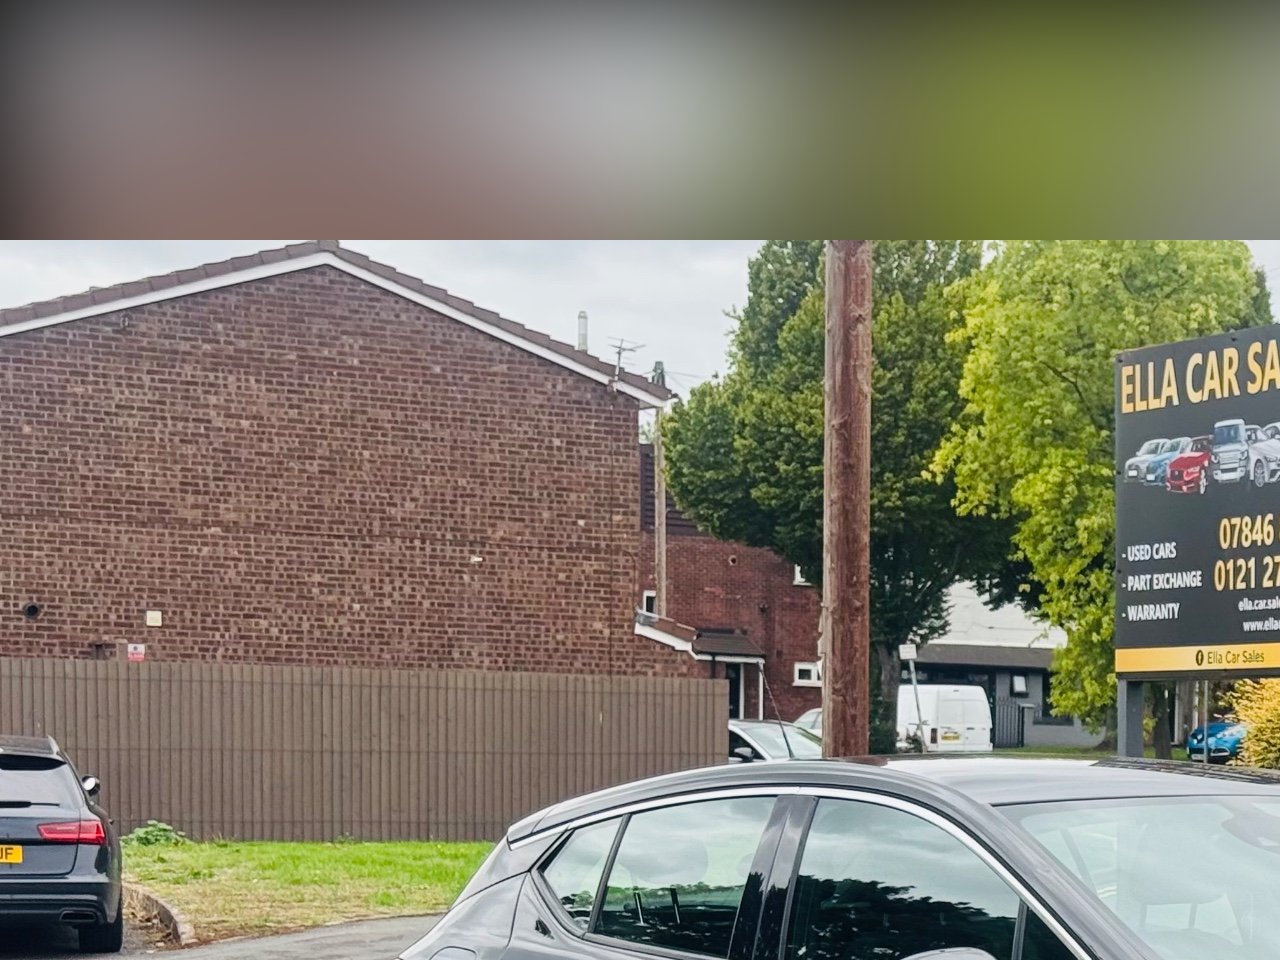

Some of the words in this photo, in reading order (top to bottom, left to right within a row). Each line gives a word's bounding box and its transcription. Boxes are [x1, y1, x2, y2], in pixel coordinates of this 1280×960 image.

[1121, 358, 1180, 414] ELLA
[1185, 347, 1241, 404] CAR
[1219, 513, 1275, 550] 07846
[1127, 544, 1151, 561] USED
[1152, 542, 1177, 559] CARS
[1127, 574, 1151, 591] PART
[1152, 570, 1202, 590] EXCHANGE
[1214, 557, 1256, 591] 0121
[1127, 602, 1180, 621] WARRANTY
[1207, 651, 1223, 664] Ella
[1225, 650, 1241, 663] Car
[1242, 650, 1265, 663] Sales
